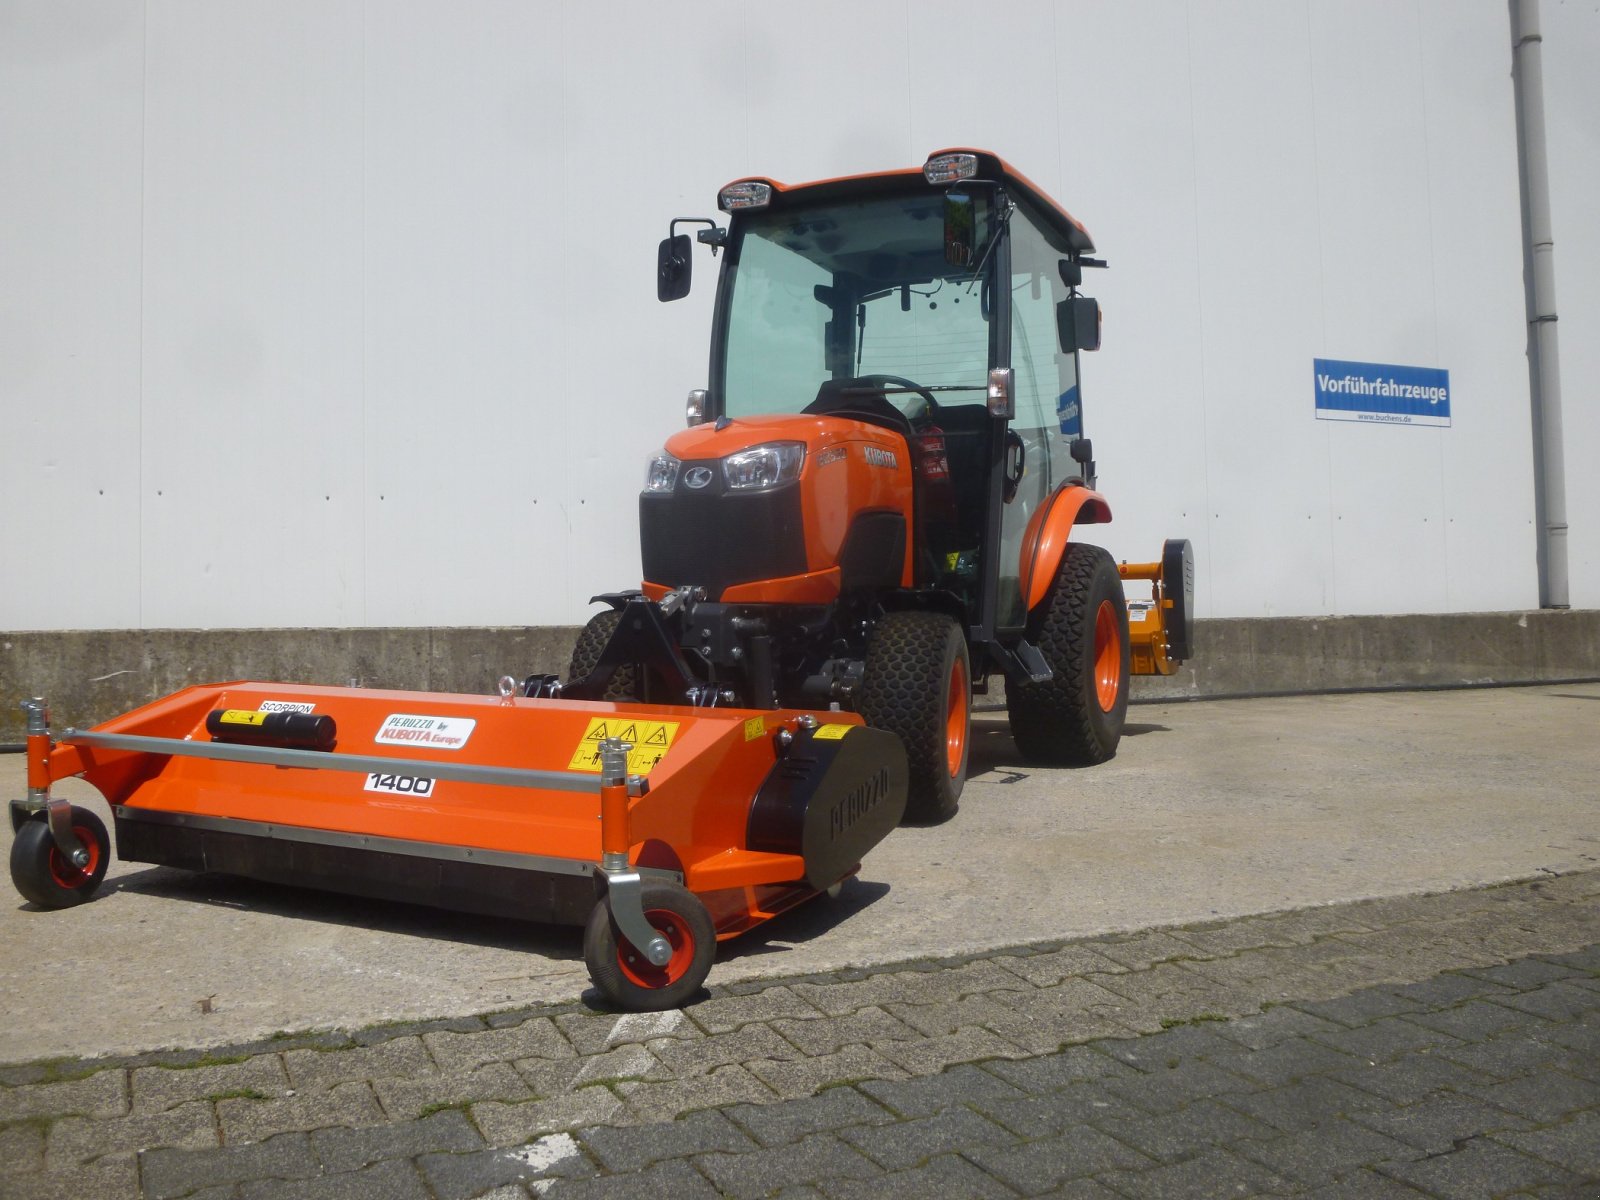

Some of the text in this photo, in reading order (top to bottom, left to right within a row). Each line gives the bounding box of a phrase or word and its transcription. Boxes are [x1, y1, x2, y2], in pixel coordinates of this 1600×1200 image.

[1317, 374, 1447, 404] Vorführfahrzeuge
[863, 446, 898, 469] KUBOTA
[260, 702, 313, 713] SCORPION
[388, 717, 448, 731] PERUZZO by
[381, 728, 461, 745] KUBOTA Europe
[371, 773, 432, 794] 1400
